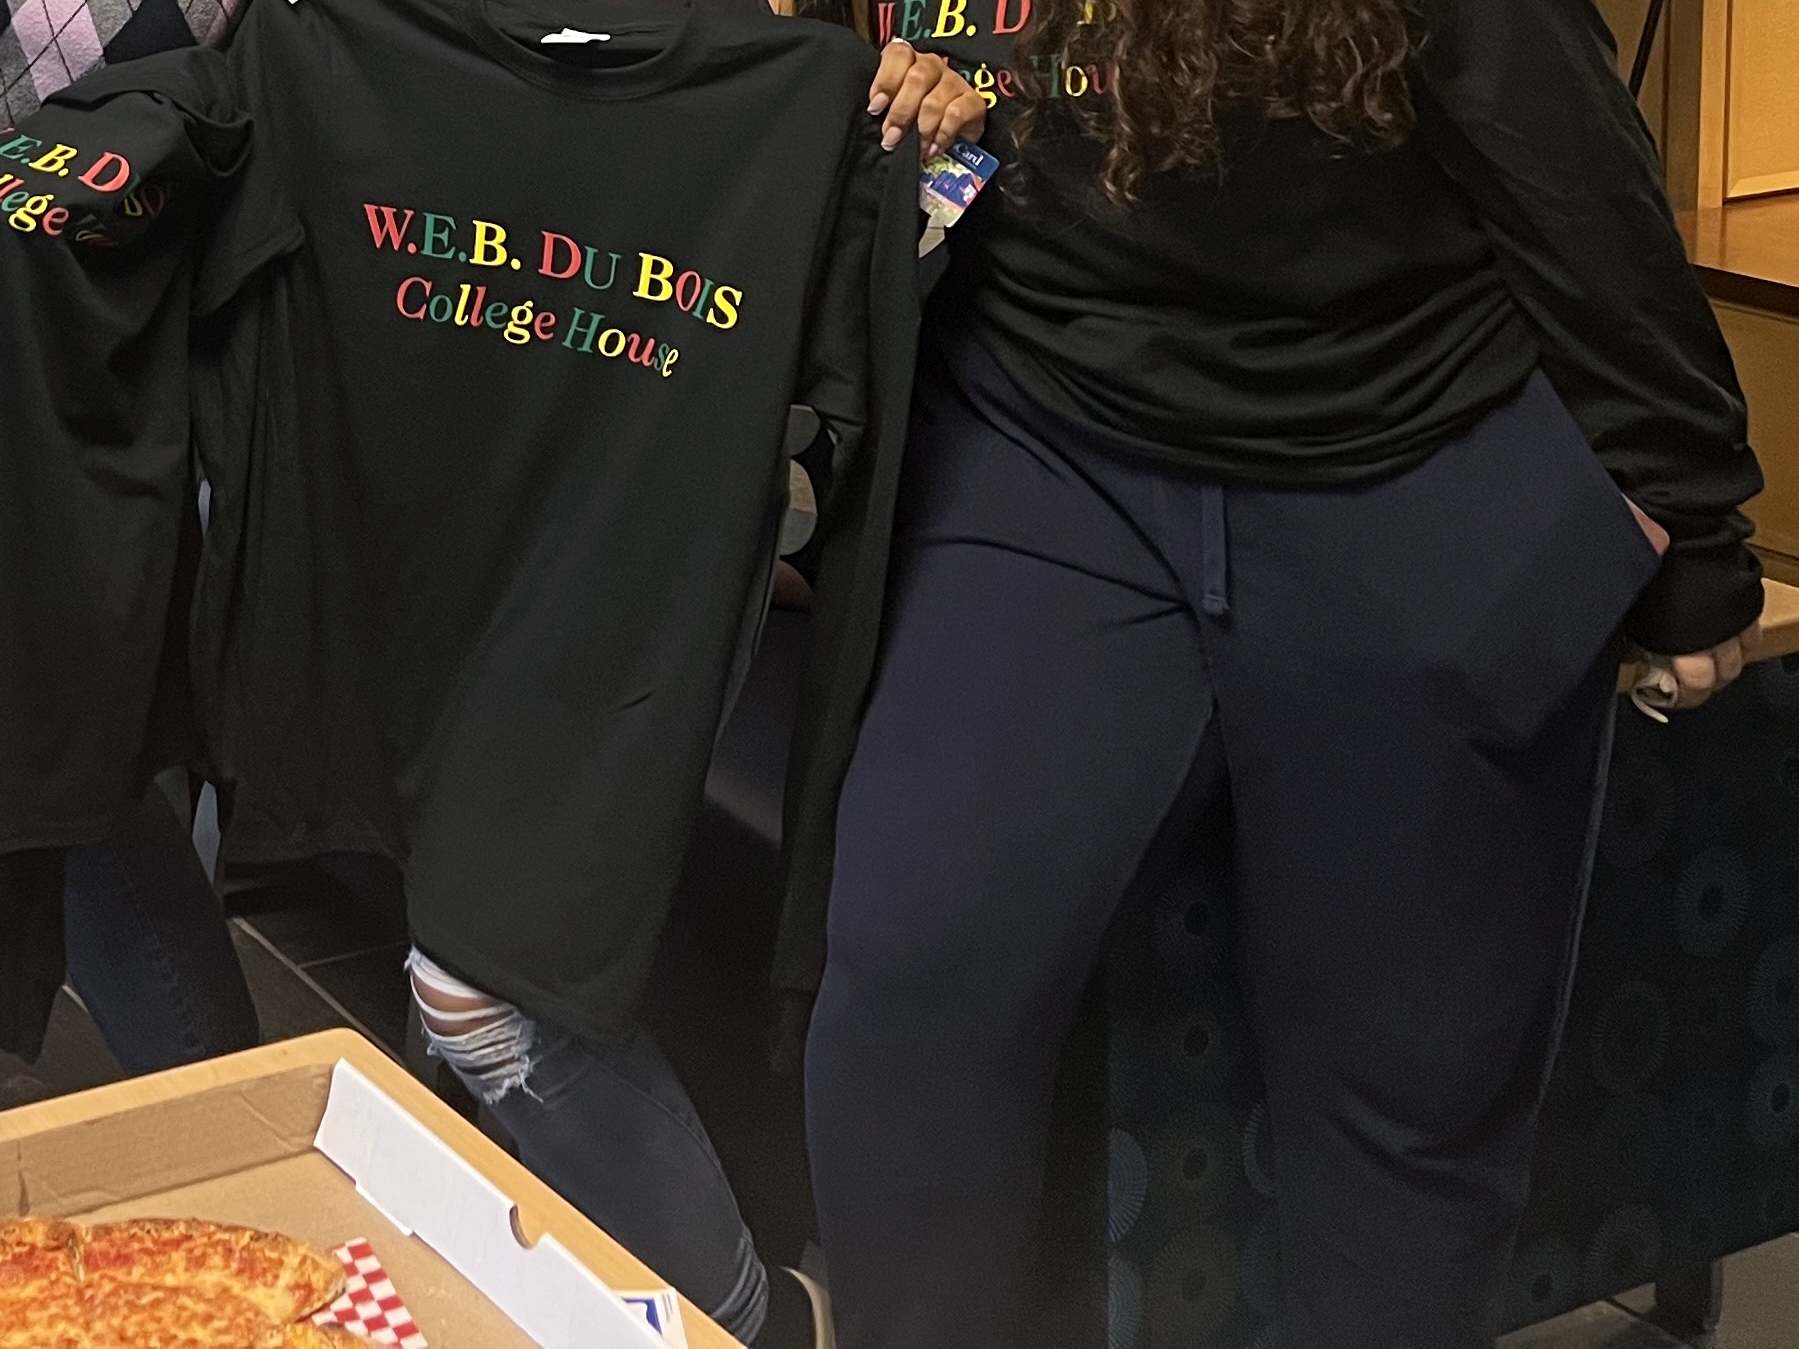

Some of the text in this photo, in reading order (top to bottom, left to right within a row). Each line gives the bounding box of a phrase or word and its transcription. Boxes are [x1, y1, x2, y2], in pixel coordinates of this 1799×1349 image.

[362, 202, 743, 330] W.E.B. DU BOIS
[395, 275, 680, 378] College House
